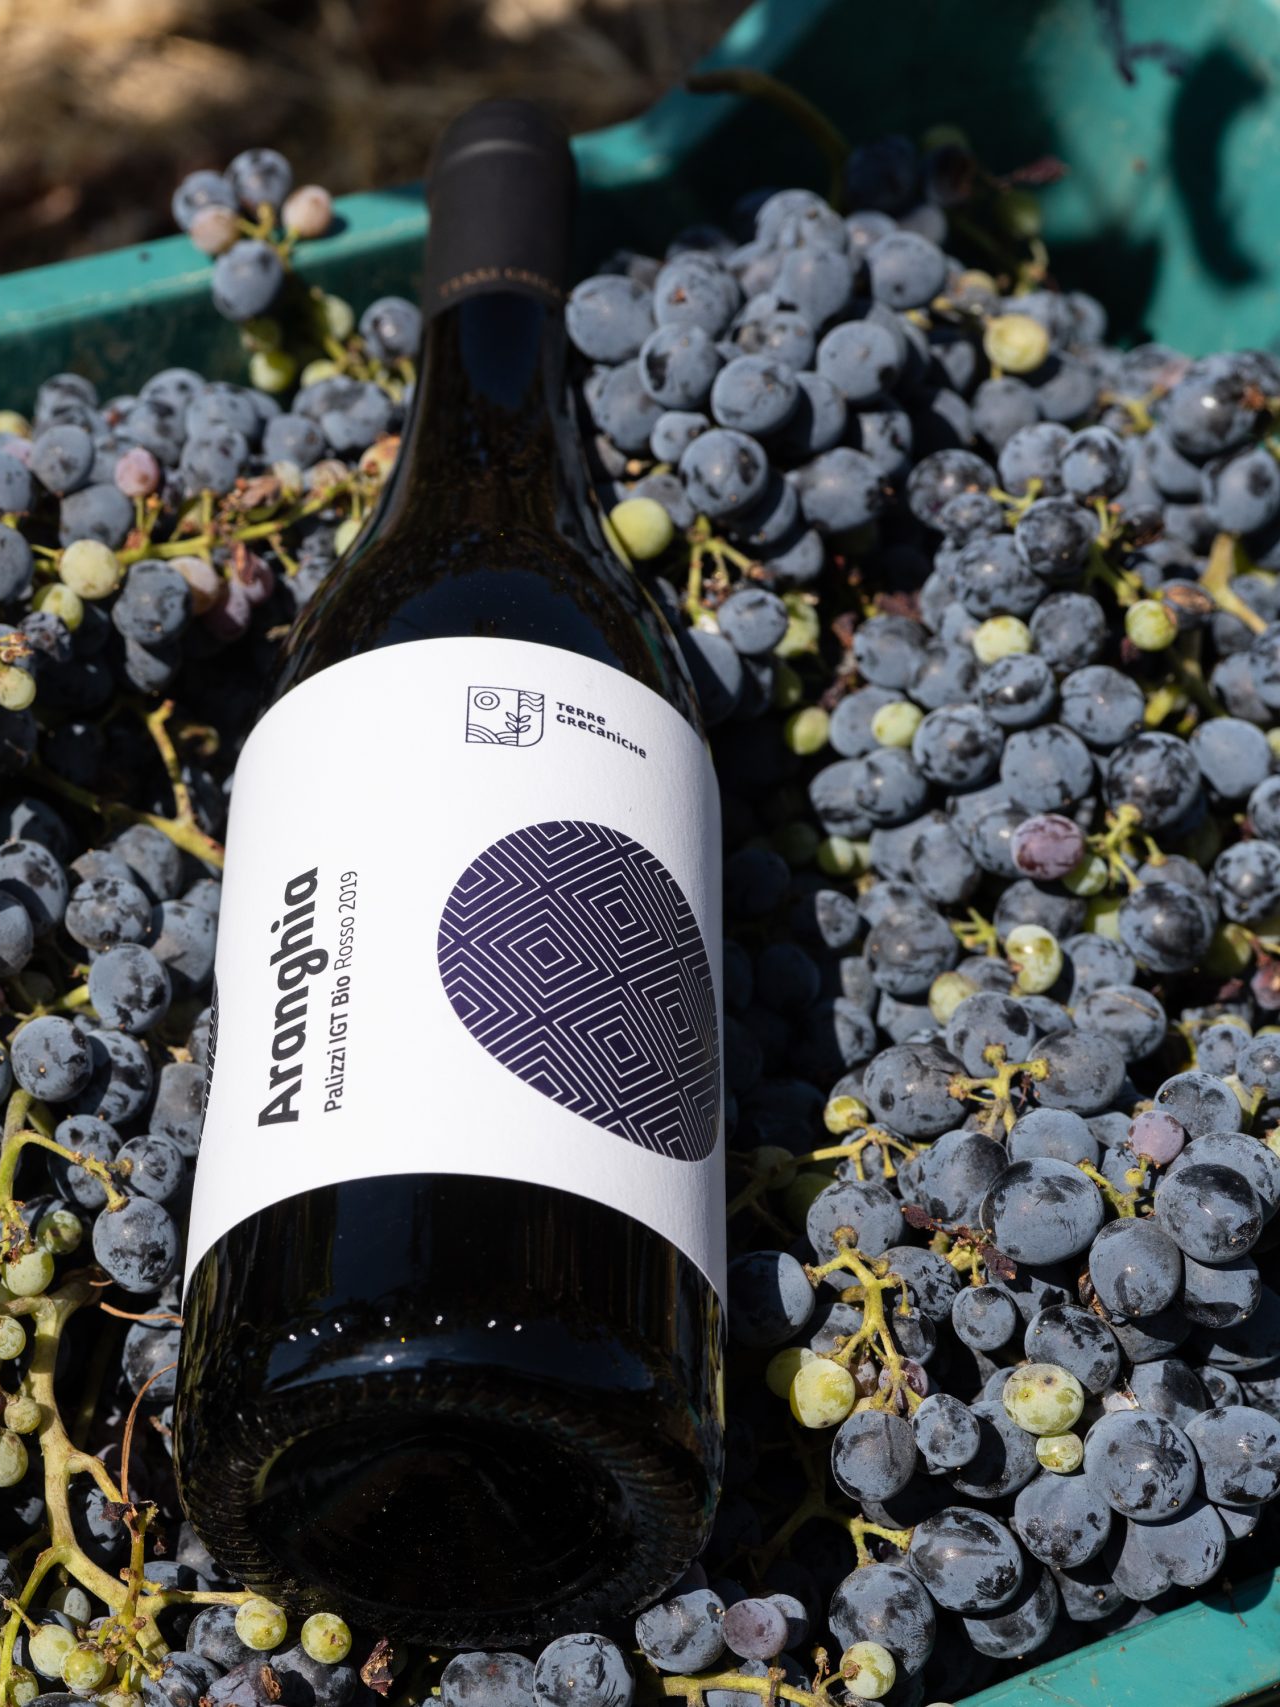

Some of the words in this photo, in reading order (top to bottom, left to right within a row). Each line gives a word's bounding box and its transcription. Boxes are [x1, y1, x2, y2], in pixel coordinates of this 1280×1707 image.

[338, 871, 358, 914] 2019
[333, 916, 355, 971] Rosso
[257, 866, 329, 1128] Aranghia
[330, 975, 351, 1008] Bio
[328, 1012, 349, 1044] IGT
[323, 1046, 346, 1113] Palizzi
